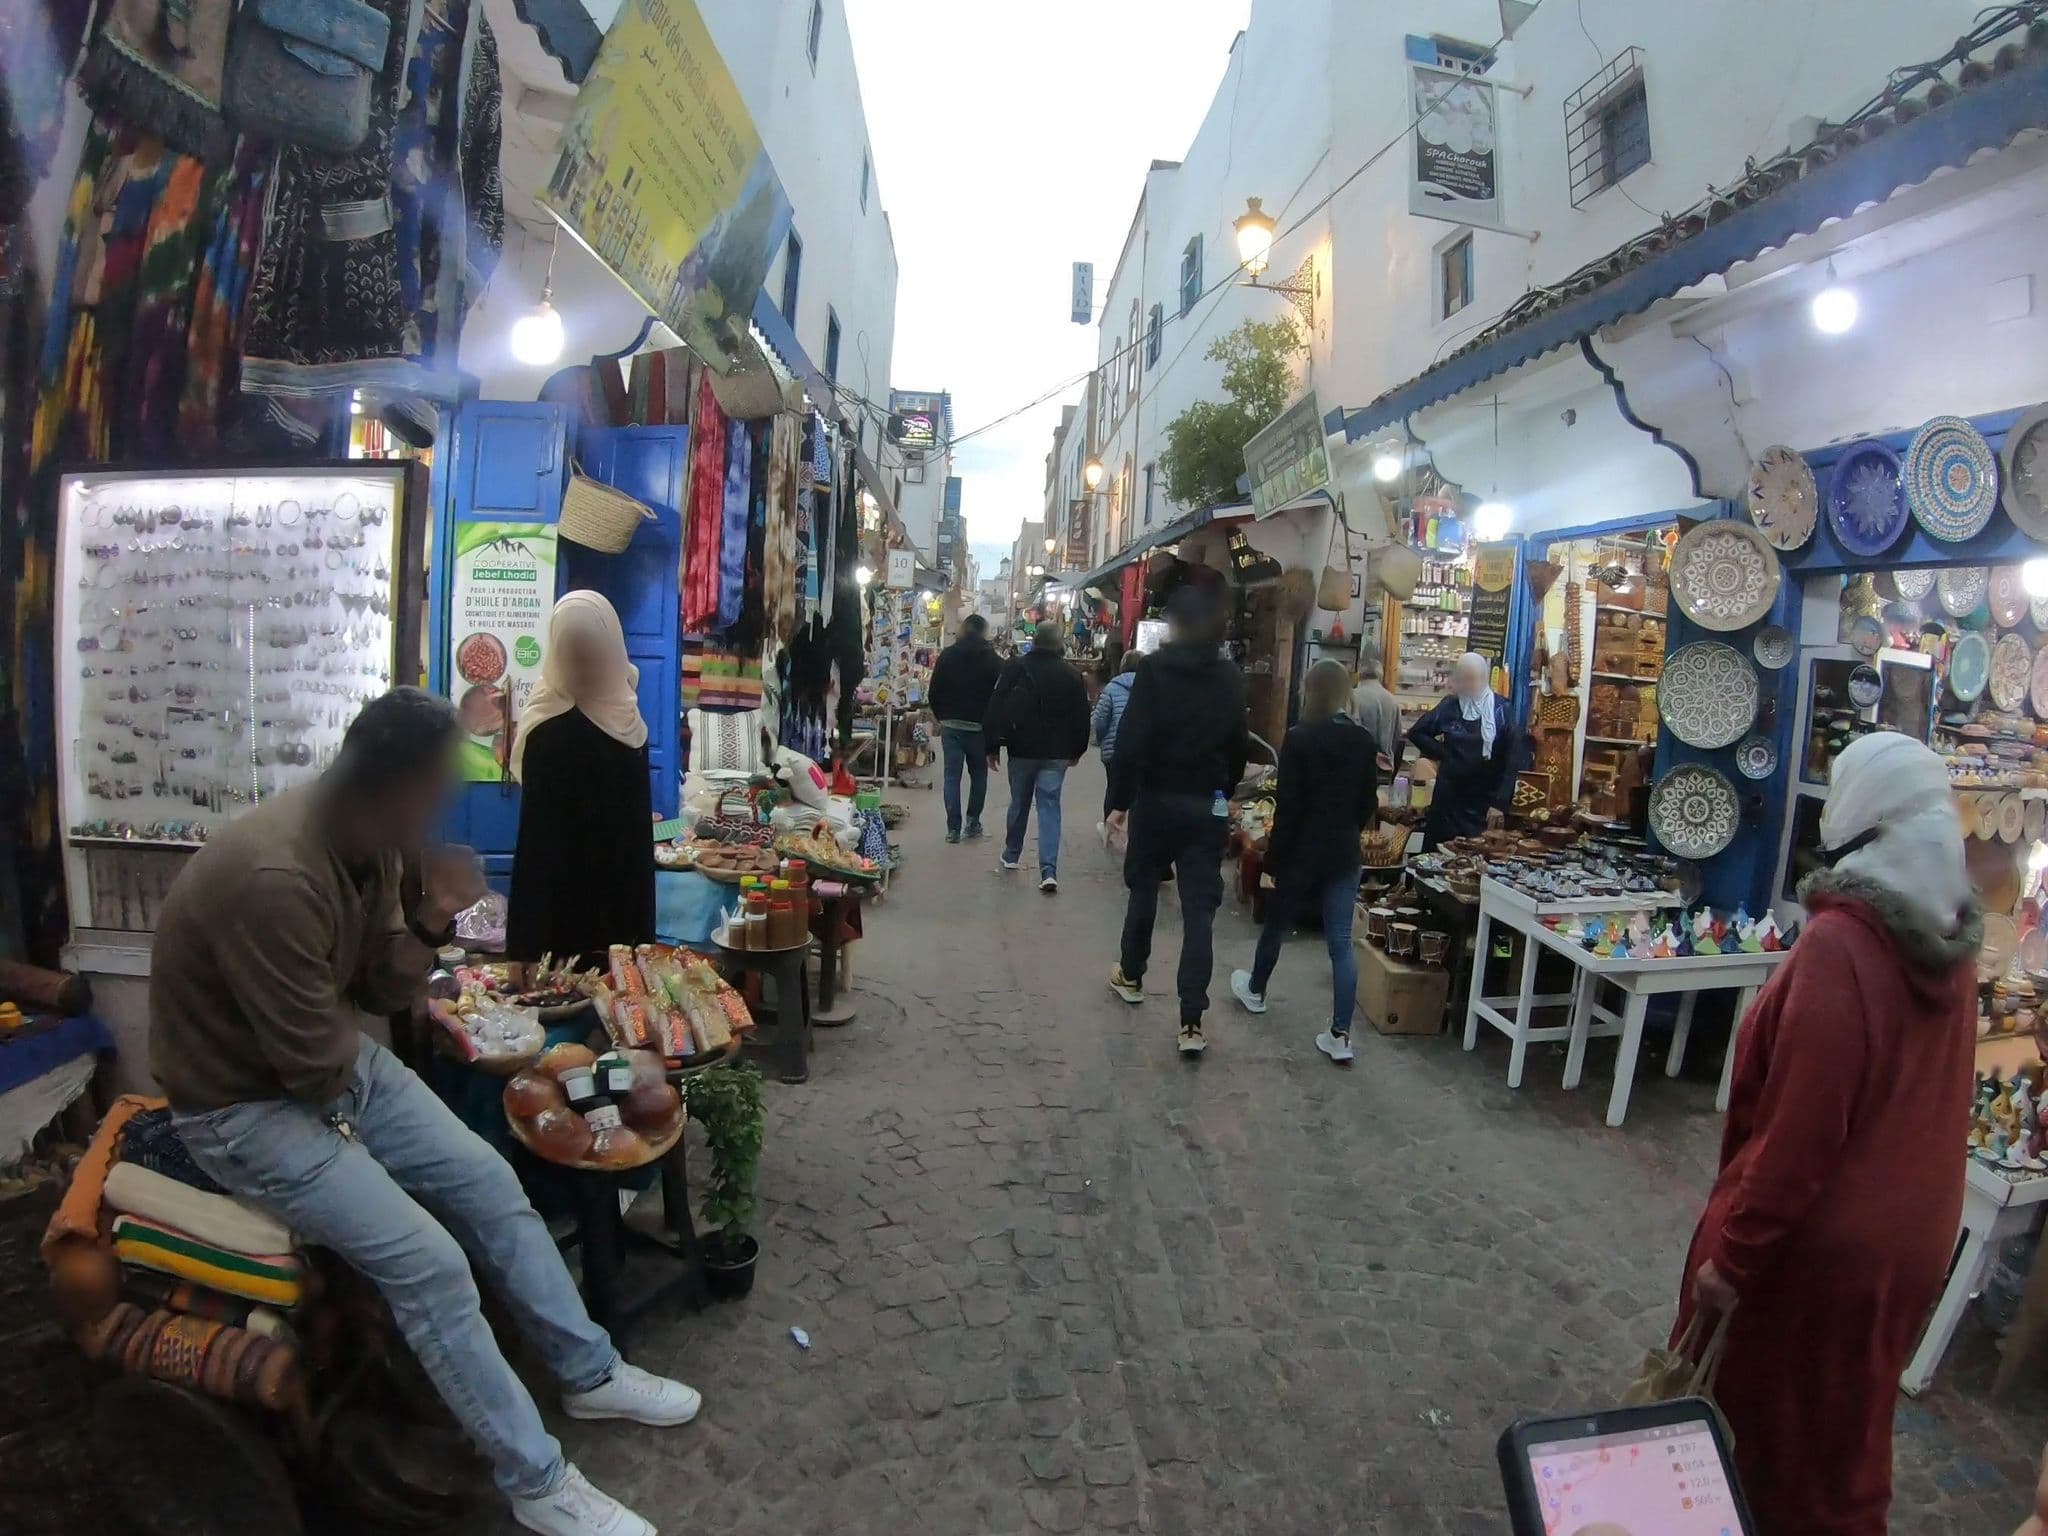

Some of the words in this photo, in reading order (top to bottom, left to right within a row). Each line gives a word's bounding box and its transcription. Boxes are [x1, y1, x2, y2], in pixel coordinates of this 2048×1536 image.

[1425, 148, 1446, 159] SPA
[1076, 263, 1089, 308] RIAD
[474, 560, 537, 569] COOPERATIVE
[895, 557, 908, 568] 10
[474, 569, 500, 579] Jebel
[498, 587, 537, 595] PRODUCTION
[466, 596, 500, 607] D'HUILE
[502, 597, 541, 608] D'ARGAN
